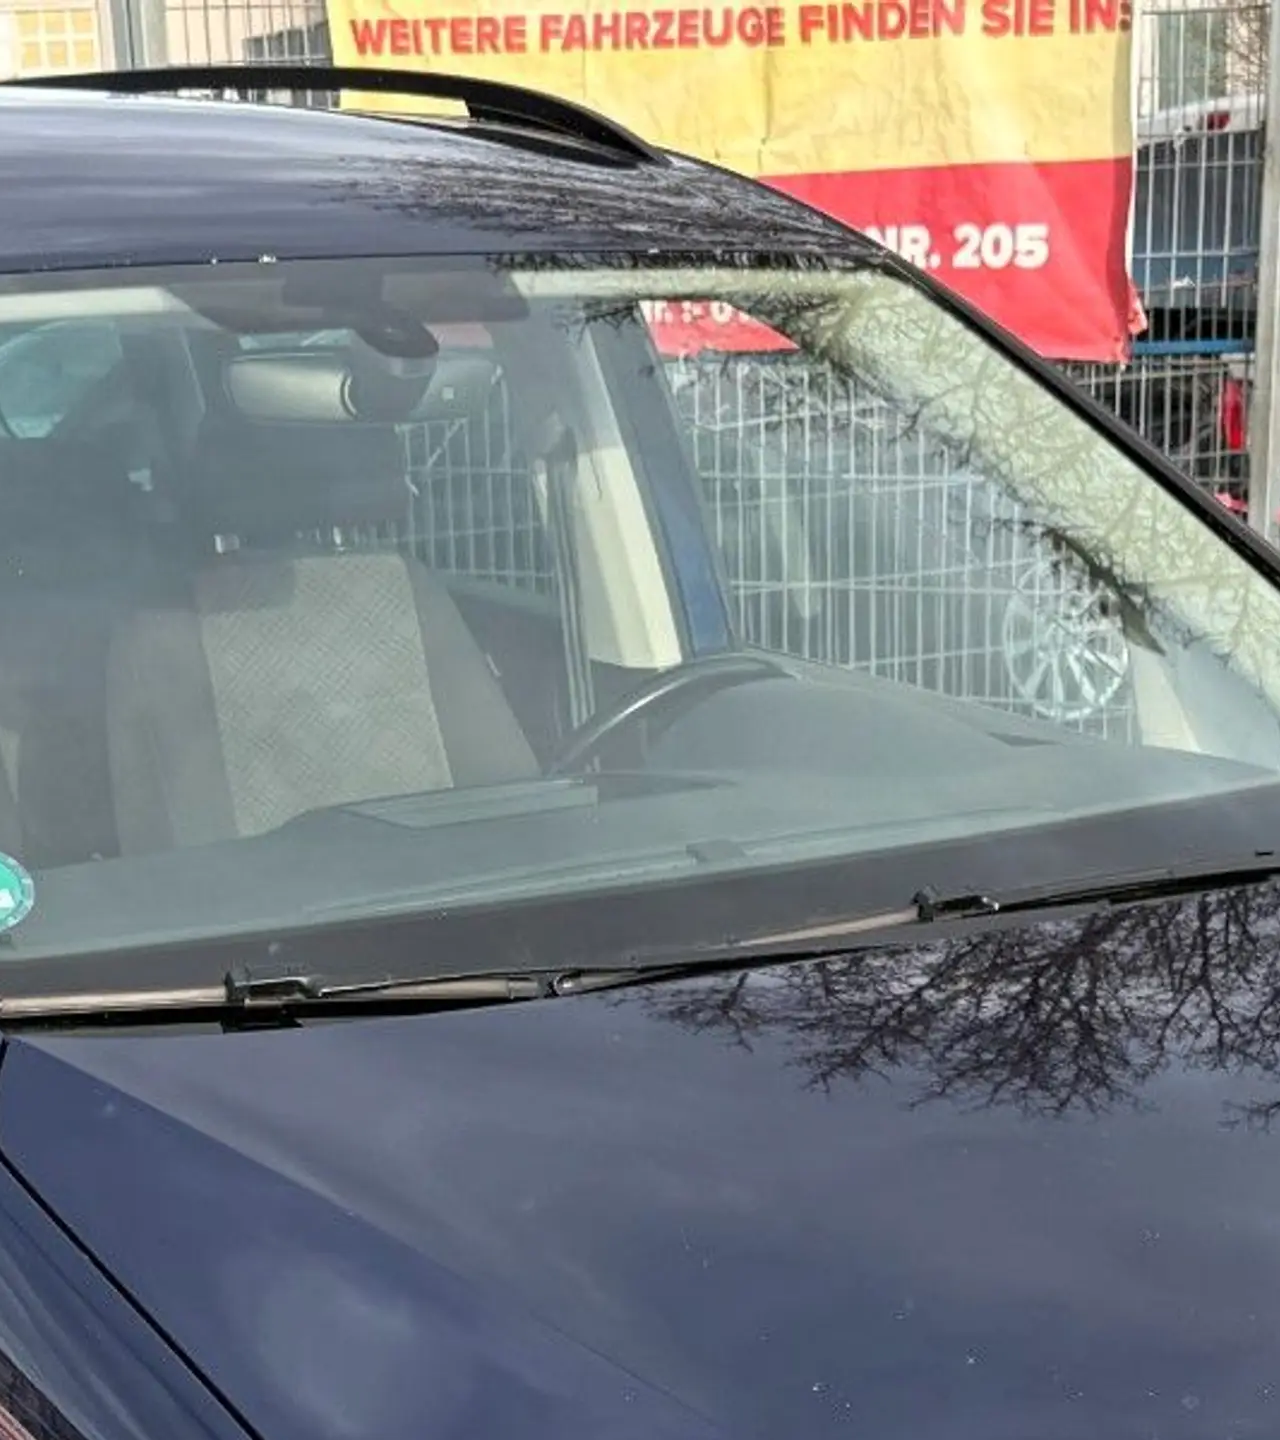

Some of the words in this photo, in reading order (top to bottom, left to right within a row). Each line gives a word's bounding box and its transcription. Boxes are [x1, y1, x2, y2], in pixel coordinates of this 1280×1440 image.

[351, 15, 528, 57] WEITERE
[540, 7, 785, 53] FAHRZEUGE
[800, 0, 965, 43] FINDEN
[981, 0, 1054, 37] SIE
[951, 222, 1049, 269] 205
